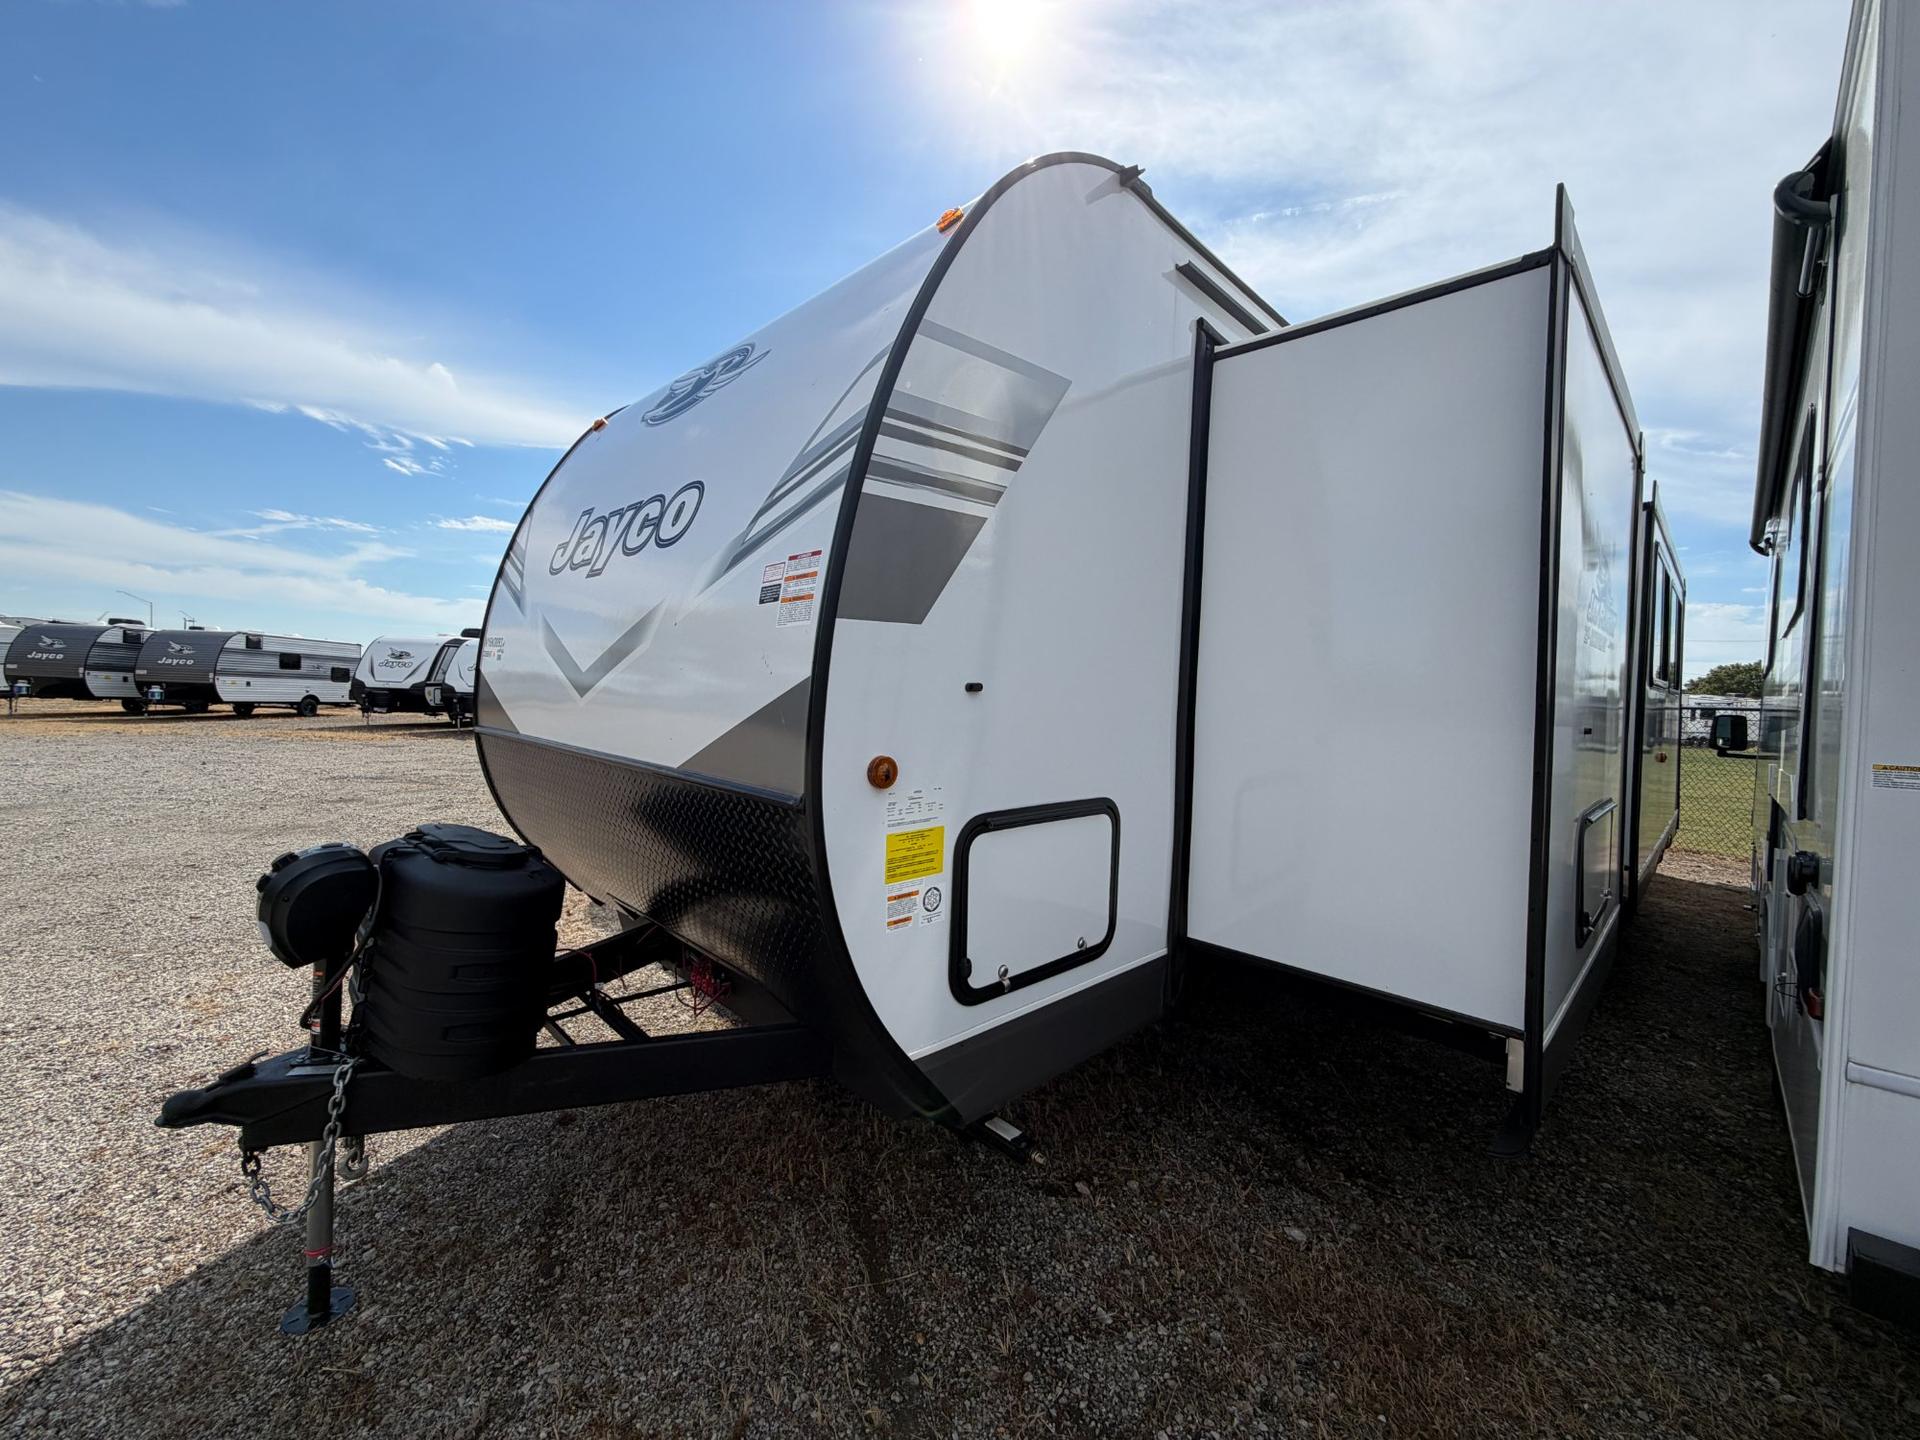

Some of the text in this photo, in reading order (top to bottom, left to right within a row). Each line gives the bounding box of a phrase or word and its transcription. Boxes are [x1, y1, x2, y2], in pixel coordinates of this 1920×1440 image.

[549, 480, 705, 579] Jayco
[27, 651, 64, 660] Jayco
[157, 656, 194, 666] Jayco
[378, 659, 413, 669] Jayco
